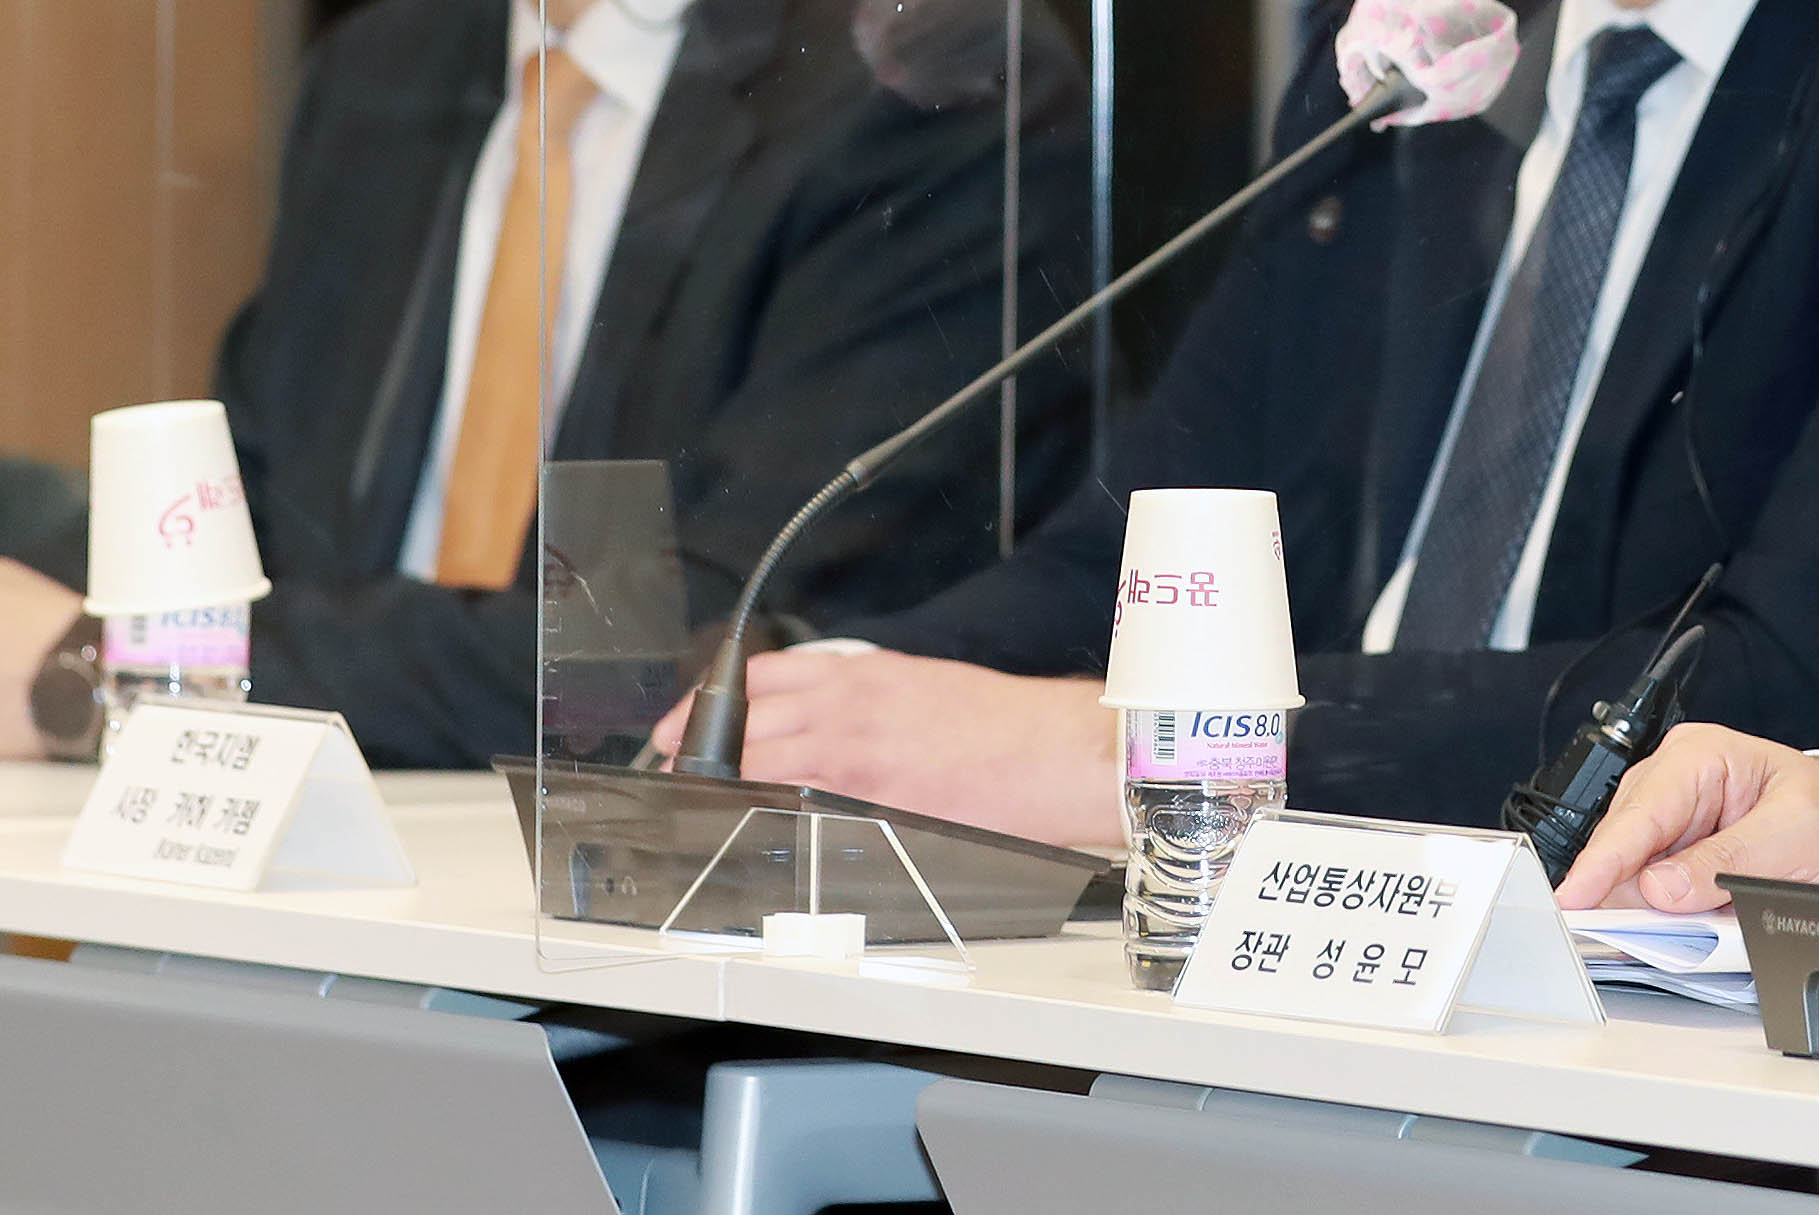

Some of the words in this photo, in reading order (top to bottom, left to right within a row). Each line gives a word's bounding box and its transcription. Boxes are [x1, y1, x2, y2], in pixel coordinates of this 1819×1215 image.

[1127, 569, 1219, 607] 꿈드래
[1190, 710, 1252, 738] ICIS
[1254, 713, 1280, 737] 8.0
[170, 729, 261, 770] 한국지엠
[113, 786, 159, 824] 사장
[1257, 861, 1459, 919] 산업통상자원부
[1231, 930, 1291, 973] 장관
